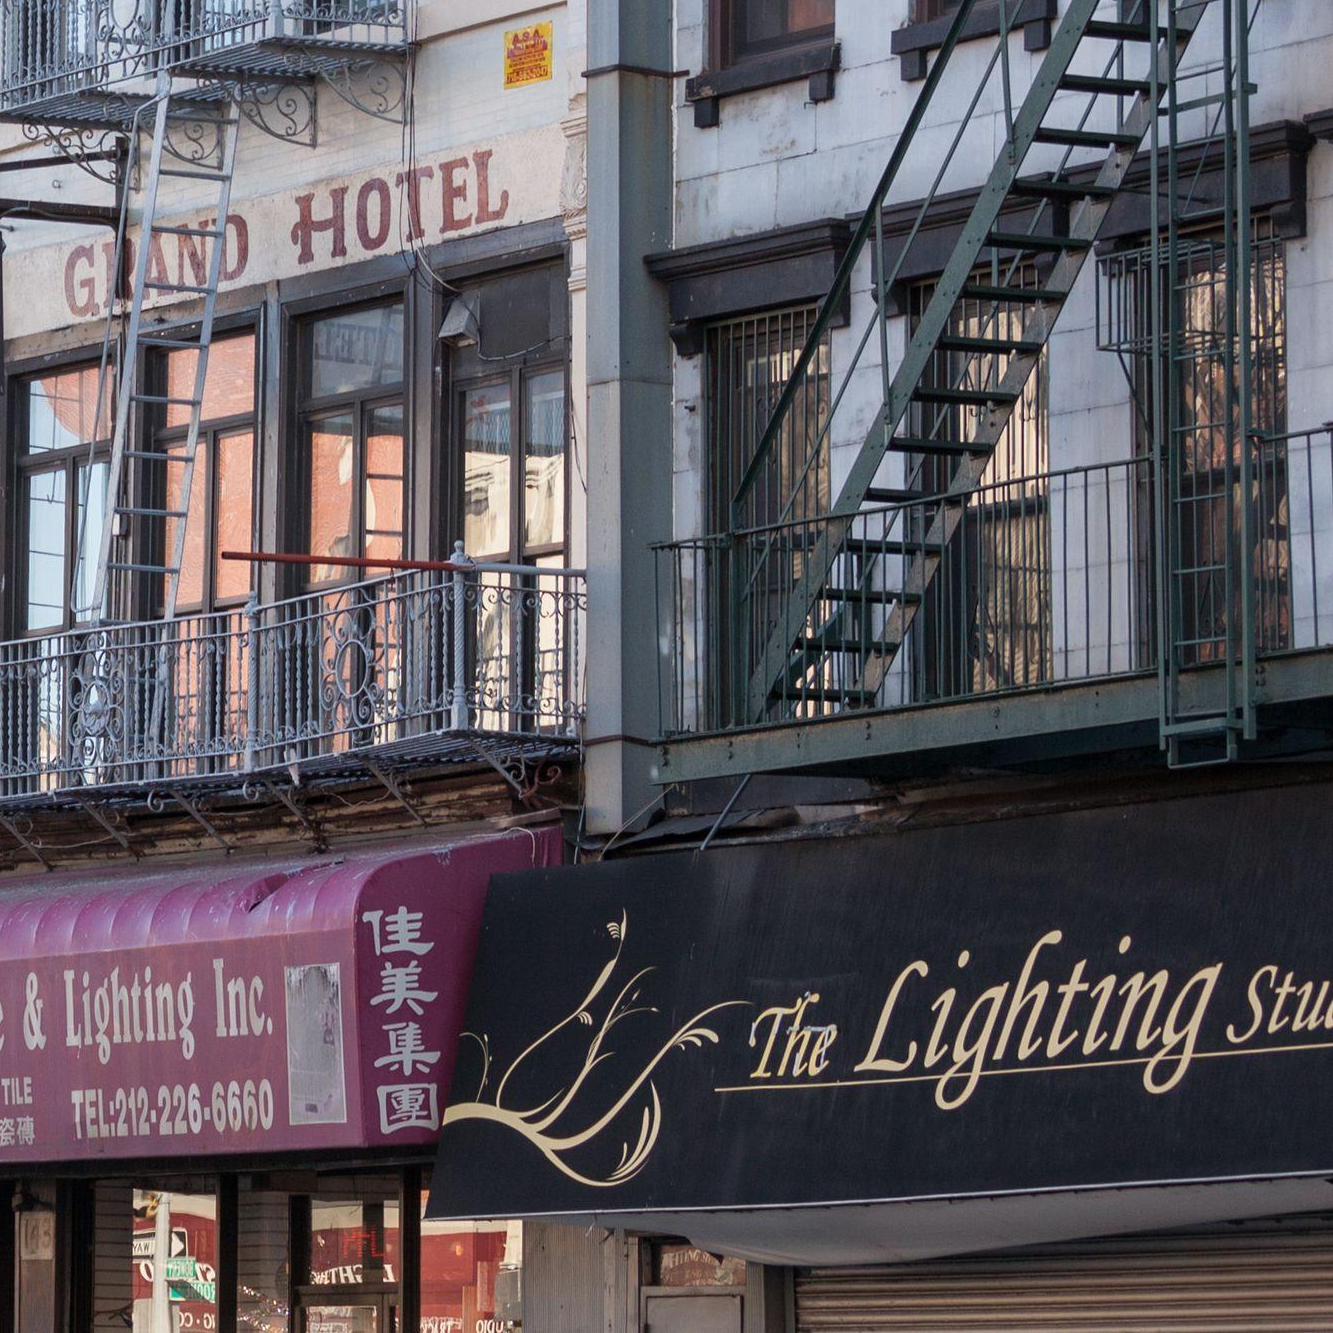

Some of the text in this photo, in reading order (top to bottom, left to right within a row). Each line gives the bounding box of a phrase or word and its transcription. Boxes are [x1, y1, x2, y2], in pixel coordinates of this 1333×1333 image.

[63, 148, 510, 319] GRAND HOTEL
[23, 972, 47, 1051] &
[64, 966, 196, 1065] Lighting
[213, 958, 273, 1038] Inc.
[362, 905, 441, 1135] 佳美集團
[748, 990, 837, 1079] The
[853, 929, 1224, 1111] Lighting
[1, 1076, 33, 1105] TILE
[71, 1078, 275, 1140] TEL:212-226-6660
